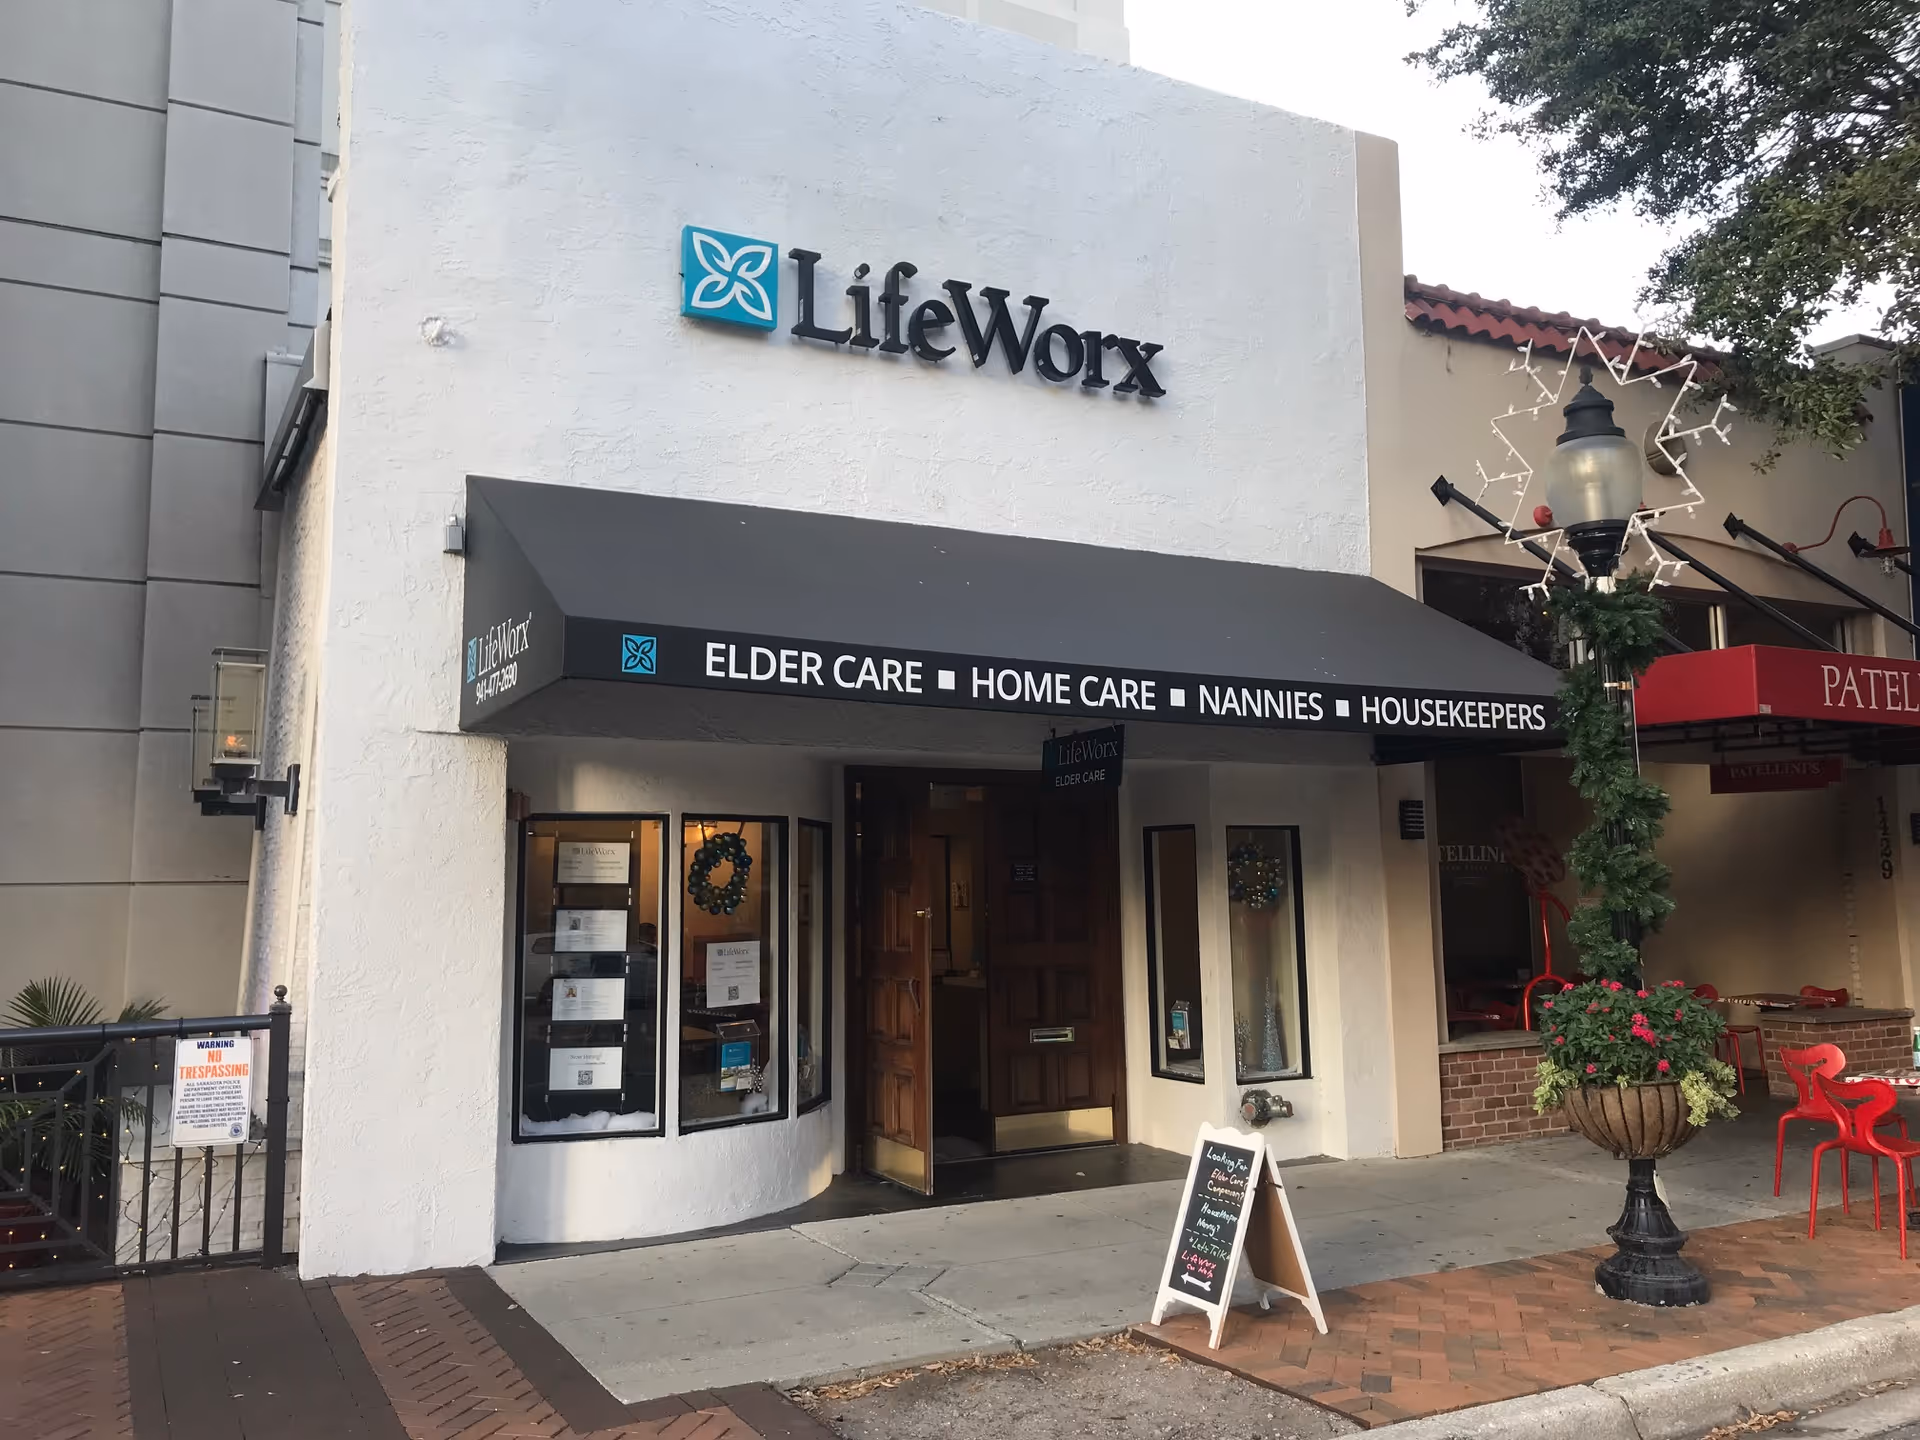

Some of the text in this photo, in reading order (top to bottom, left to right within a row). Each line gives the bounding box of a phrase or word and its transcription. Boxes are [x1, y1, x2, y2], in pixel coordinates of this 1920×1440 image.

[788, 247, 1166, 398] LifeWorx
[705, 641, 923, 694] ELDER CARE
[972, 666, 1157, 711] HOME CARE
[1821, 664, 1920, 712] PATEL
[1199, 684, 1324, 721] NANNIES
[1361, 695, 1547, 731] HOUSEKEEPERS
[1058, 738, 1118, 766] LifeWorx
[1055, 769, 1105, 787] ELDER CARE
[1729, 760, 1822, 779] PATELLINI'S
[197, 1040, 234, 1049] WARNING
[207, 1050, 222, 1063] NO
[180, 1063, 248, 1079] TRESPASSING
[1207, 1146, 1248, 1173] Looking For
